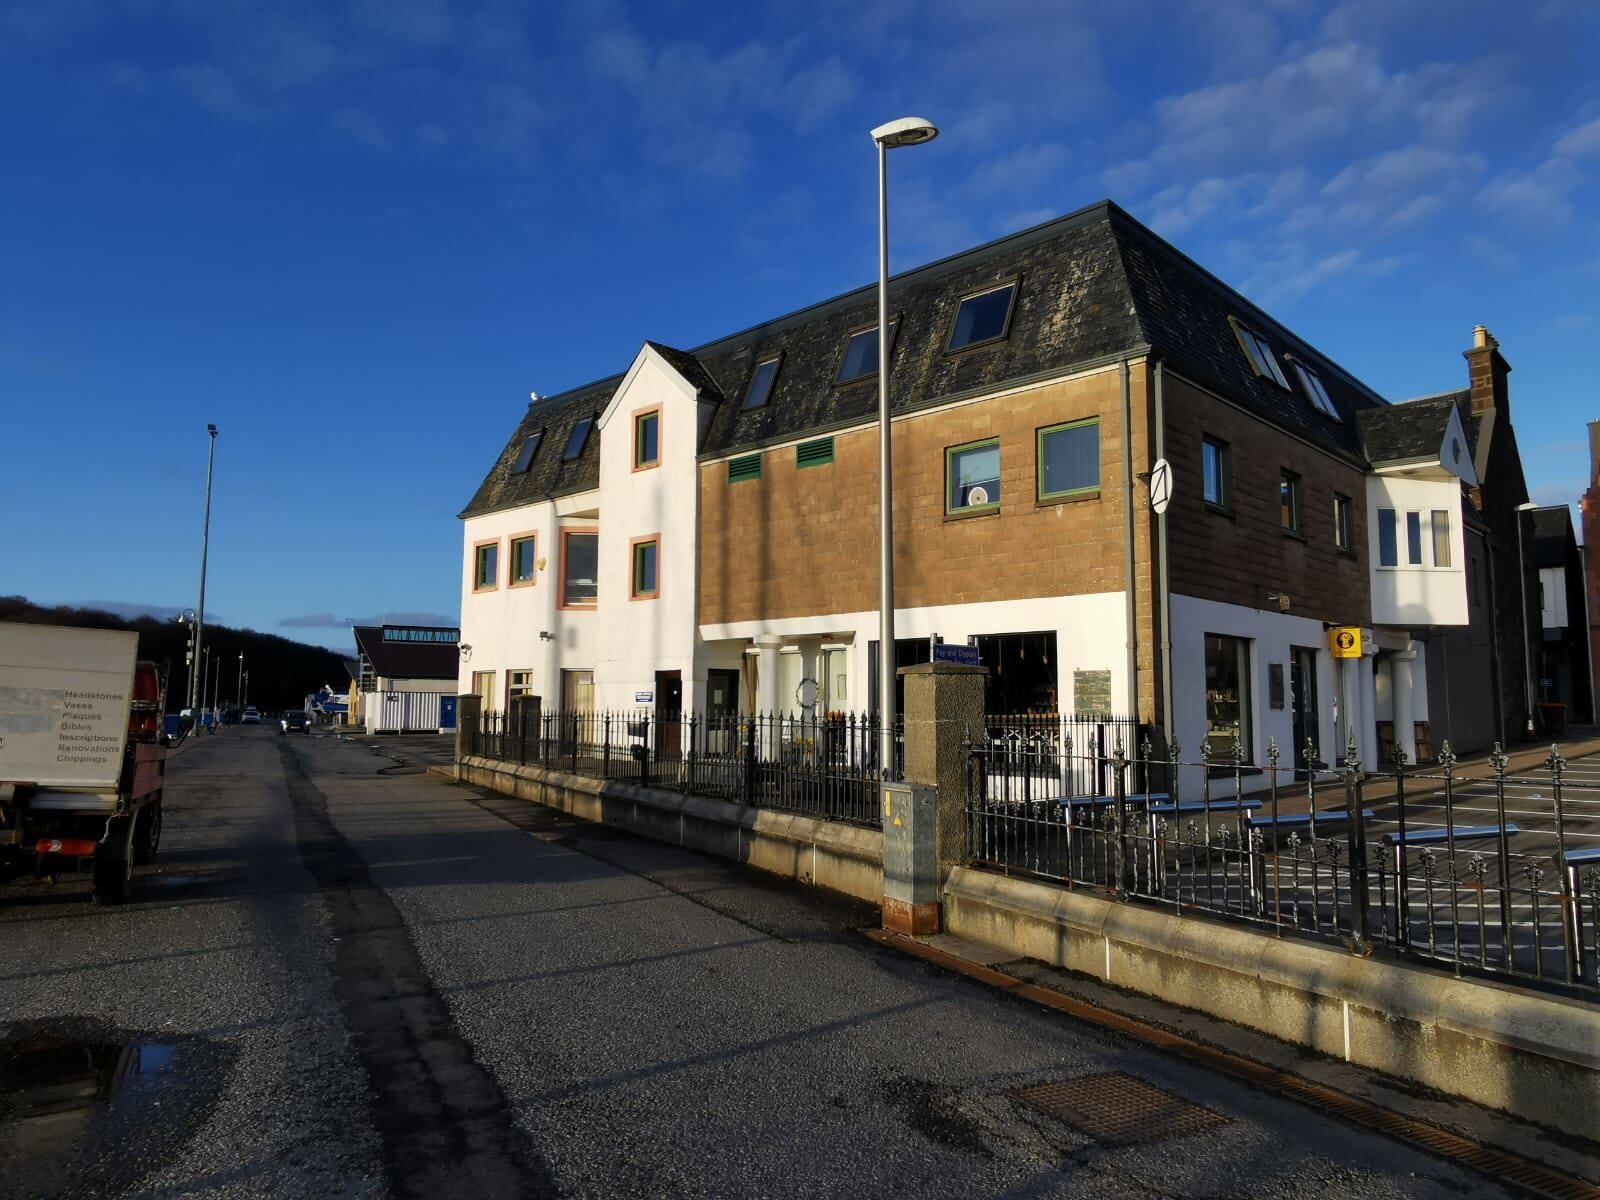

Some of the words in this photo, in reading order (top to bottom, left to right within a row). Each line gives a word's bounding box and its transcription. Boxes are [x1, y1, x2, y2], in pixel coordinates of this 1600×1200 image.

[65, 690, 123, 700] Headstones
[64, 701, 93, 710] Vases
[62, 712, 102, 721] Plaques
[60, 722, 92, 731] Bibles
[59, 733, 118, 743] Inscriptions
[58, 743, 120, 753] Renovations
[56, 754, 107, 764] Chippings
